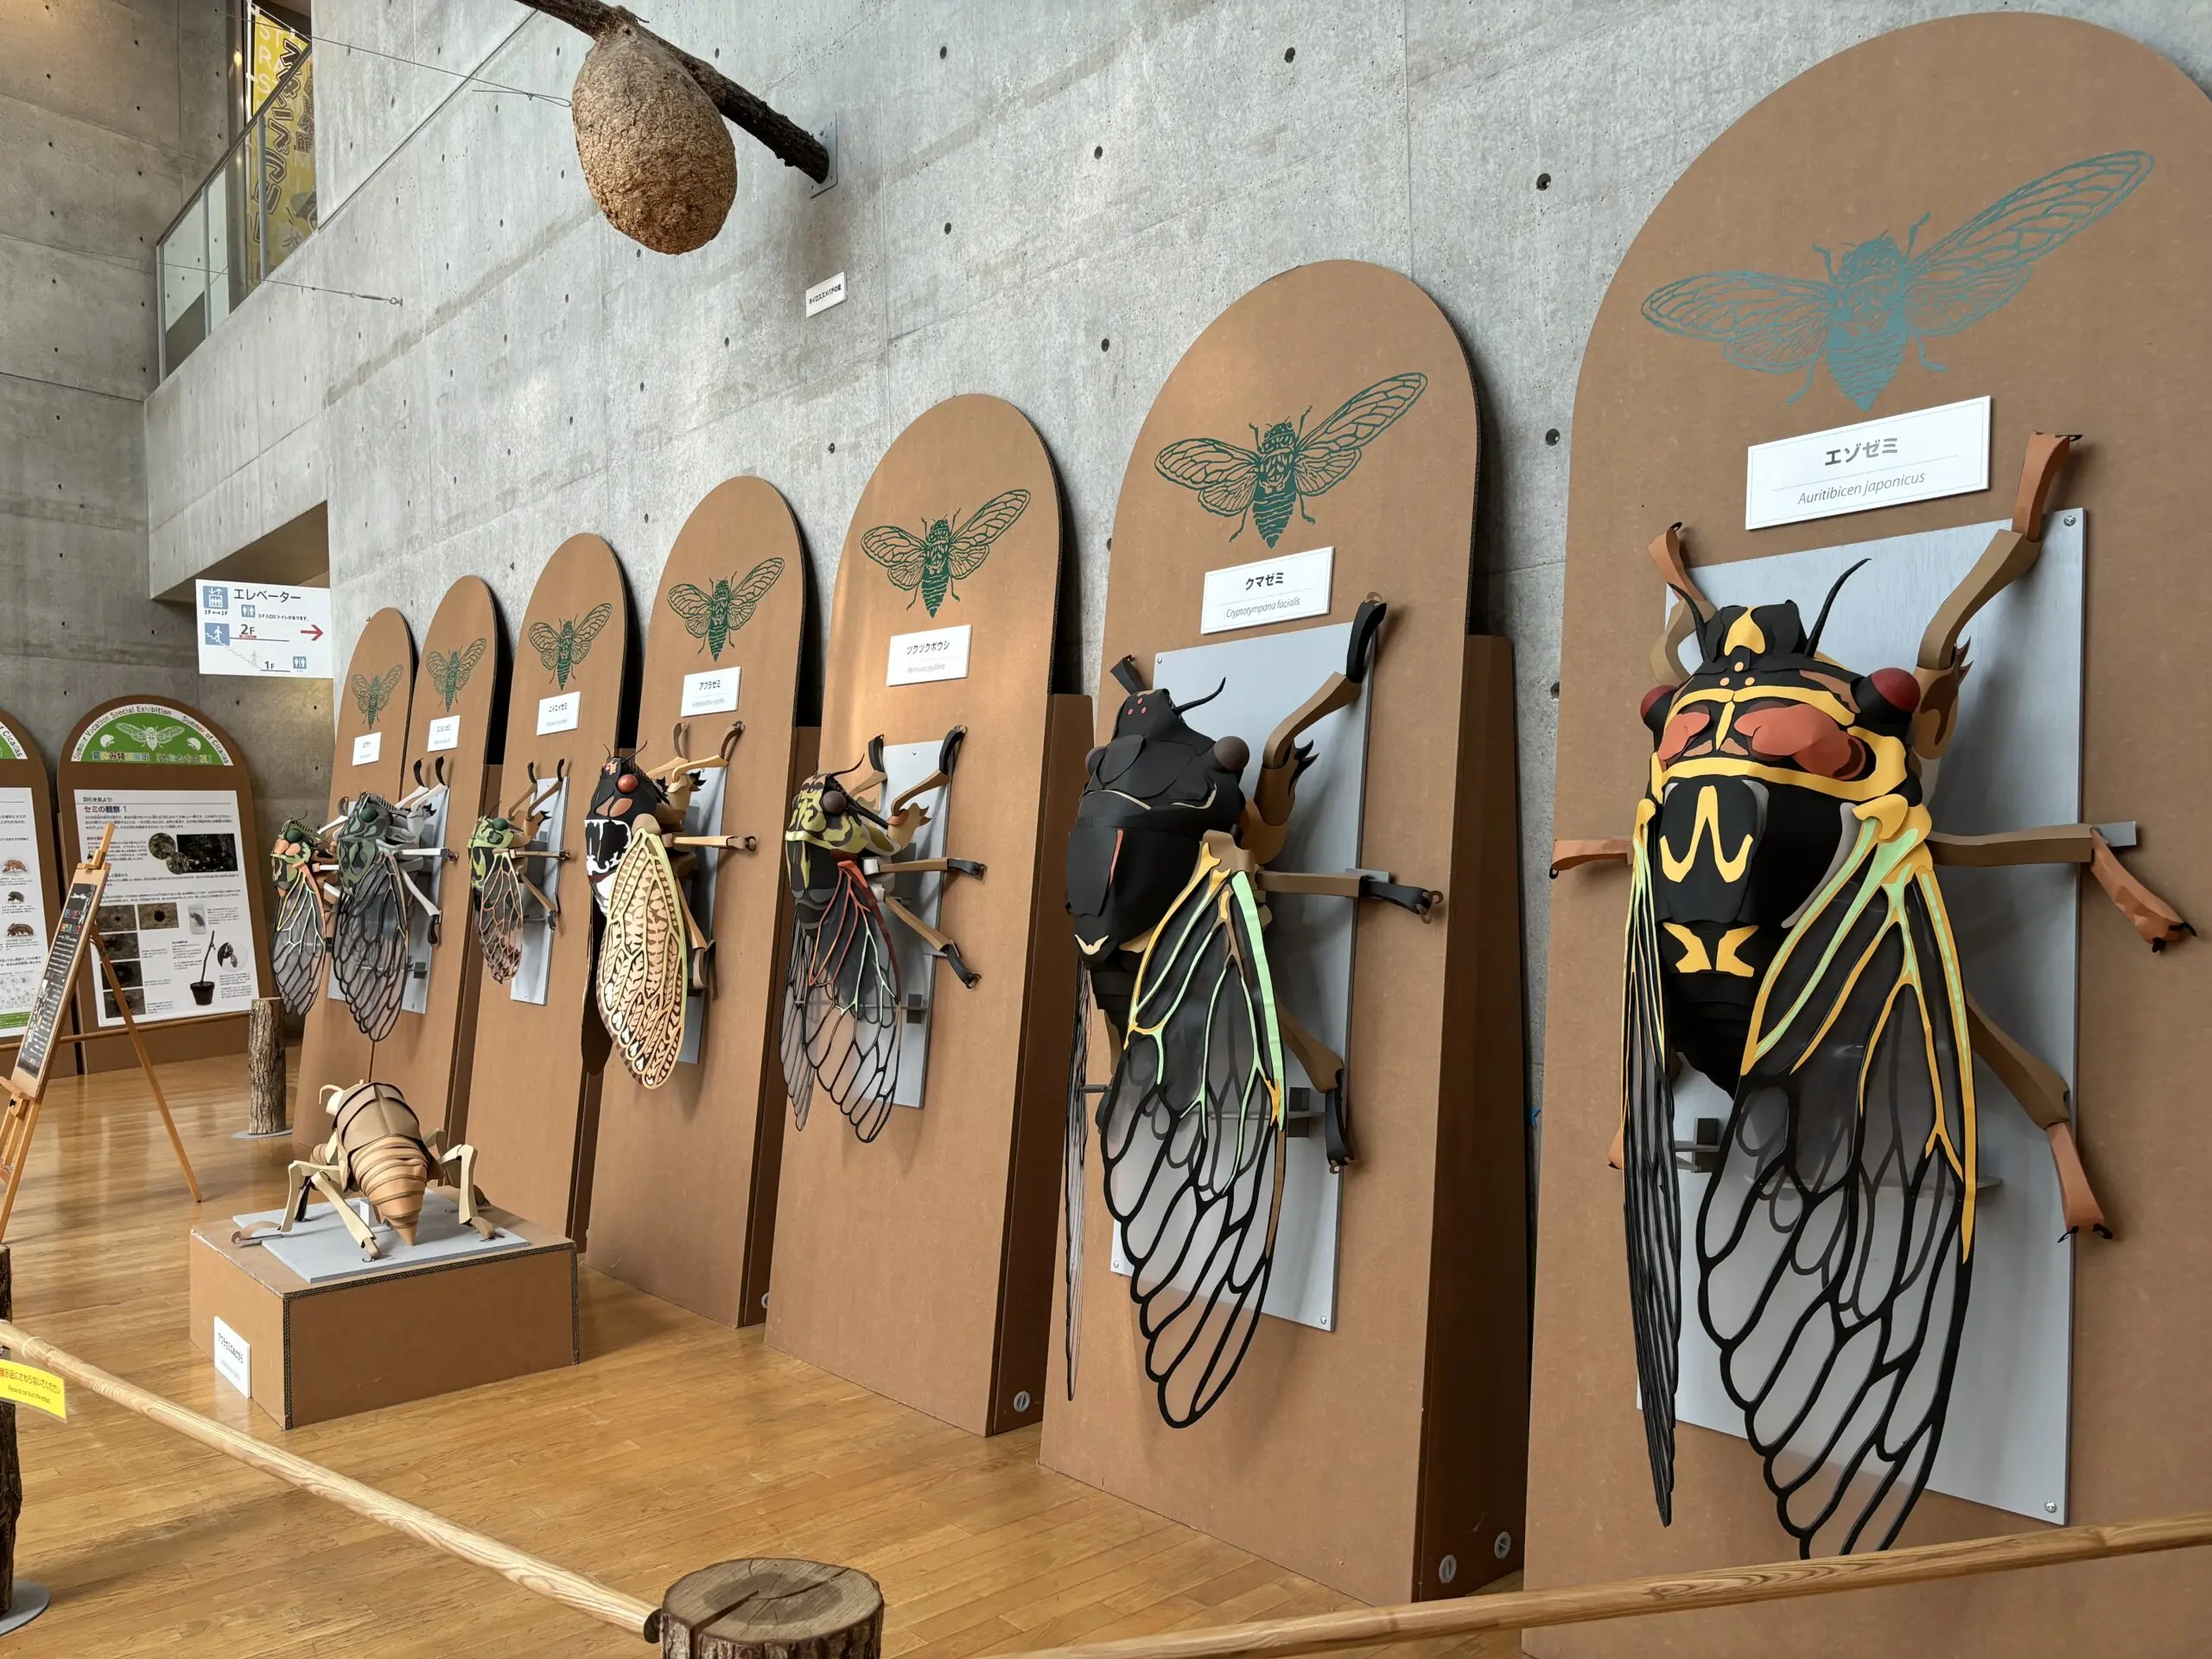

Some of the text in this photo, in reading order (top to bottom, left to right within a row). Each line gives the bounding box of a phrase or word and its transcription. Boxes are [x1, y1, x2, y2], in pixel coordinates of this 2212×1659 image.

[1824, 437, 1898, 467] エゾゼミ
[1797, 472, 1925, 505] Auritibicen japonicus
[1245, 572, 1284, 591] クマゼミ
[233, 588, 302, 603] エレベーター
[1226, 597, 1300, 619] Cryptotympana facialis
[240, 624, 256, 635] 2F
[906, 640, 950, 655] ツクツクボウシ
[264, 660, 276, 670] 1F
[110, 706, 135, 720] Special
[136, 705, 172, 716] Exhibition
